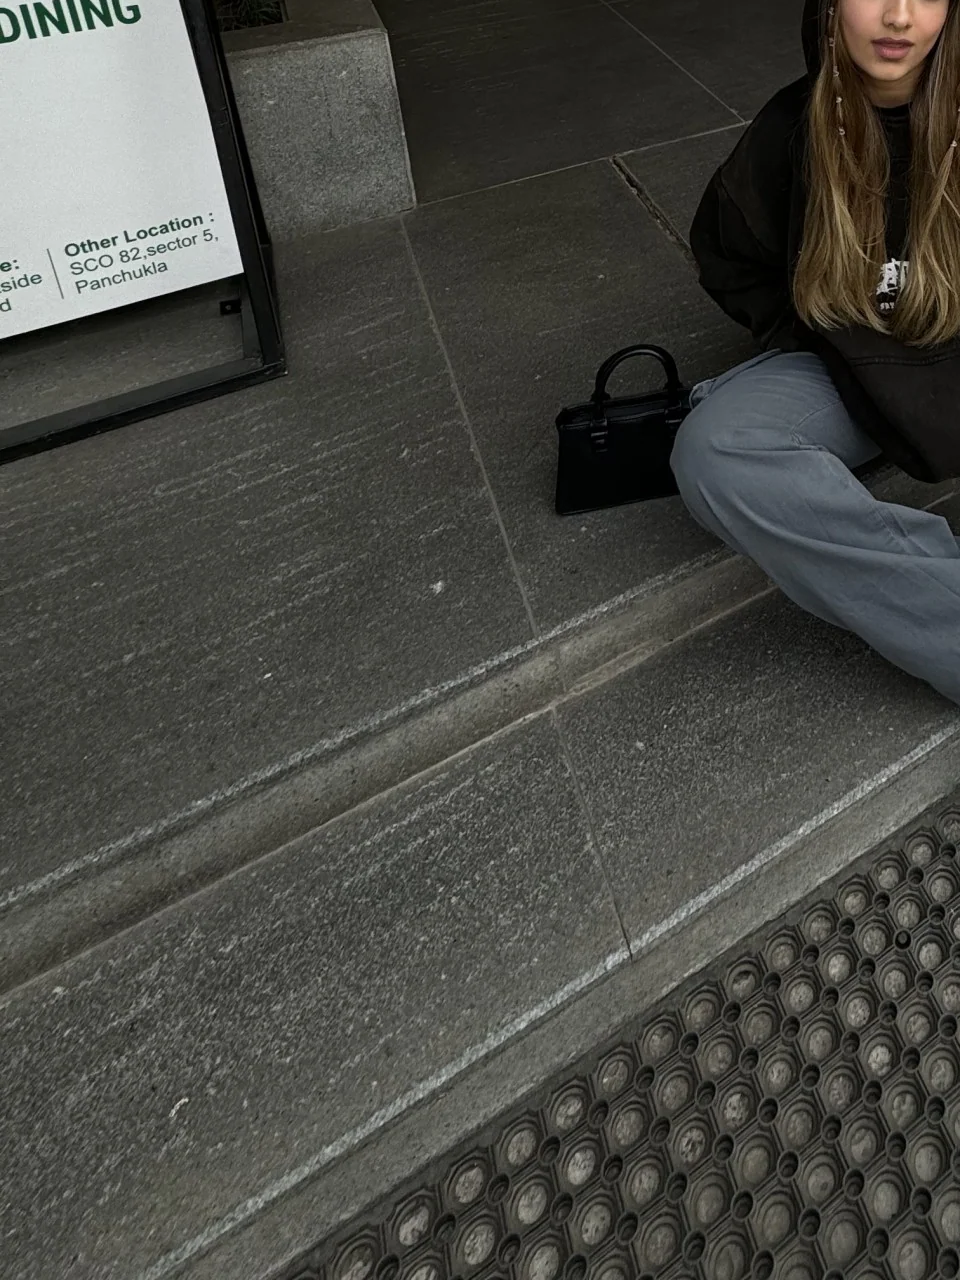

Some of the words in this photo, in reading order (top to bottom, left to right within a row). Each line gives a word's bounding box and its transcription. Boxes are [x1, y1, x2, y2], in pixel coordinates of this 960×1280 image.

[64, 235, 119, 257] Other
[123, 214, 204, 243] Location
[208, 212, 215, 222] :
[69, 254, 114, 276] SCO
[203, 228, 219, 243] 5,
[0, 273, 42, 293] side
[75, 260, 168, 294] Panchukla
